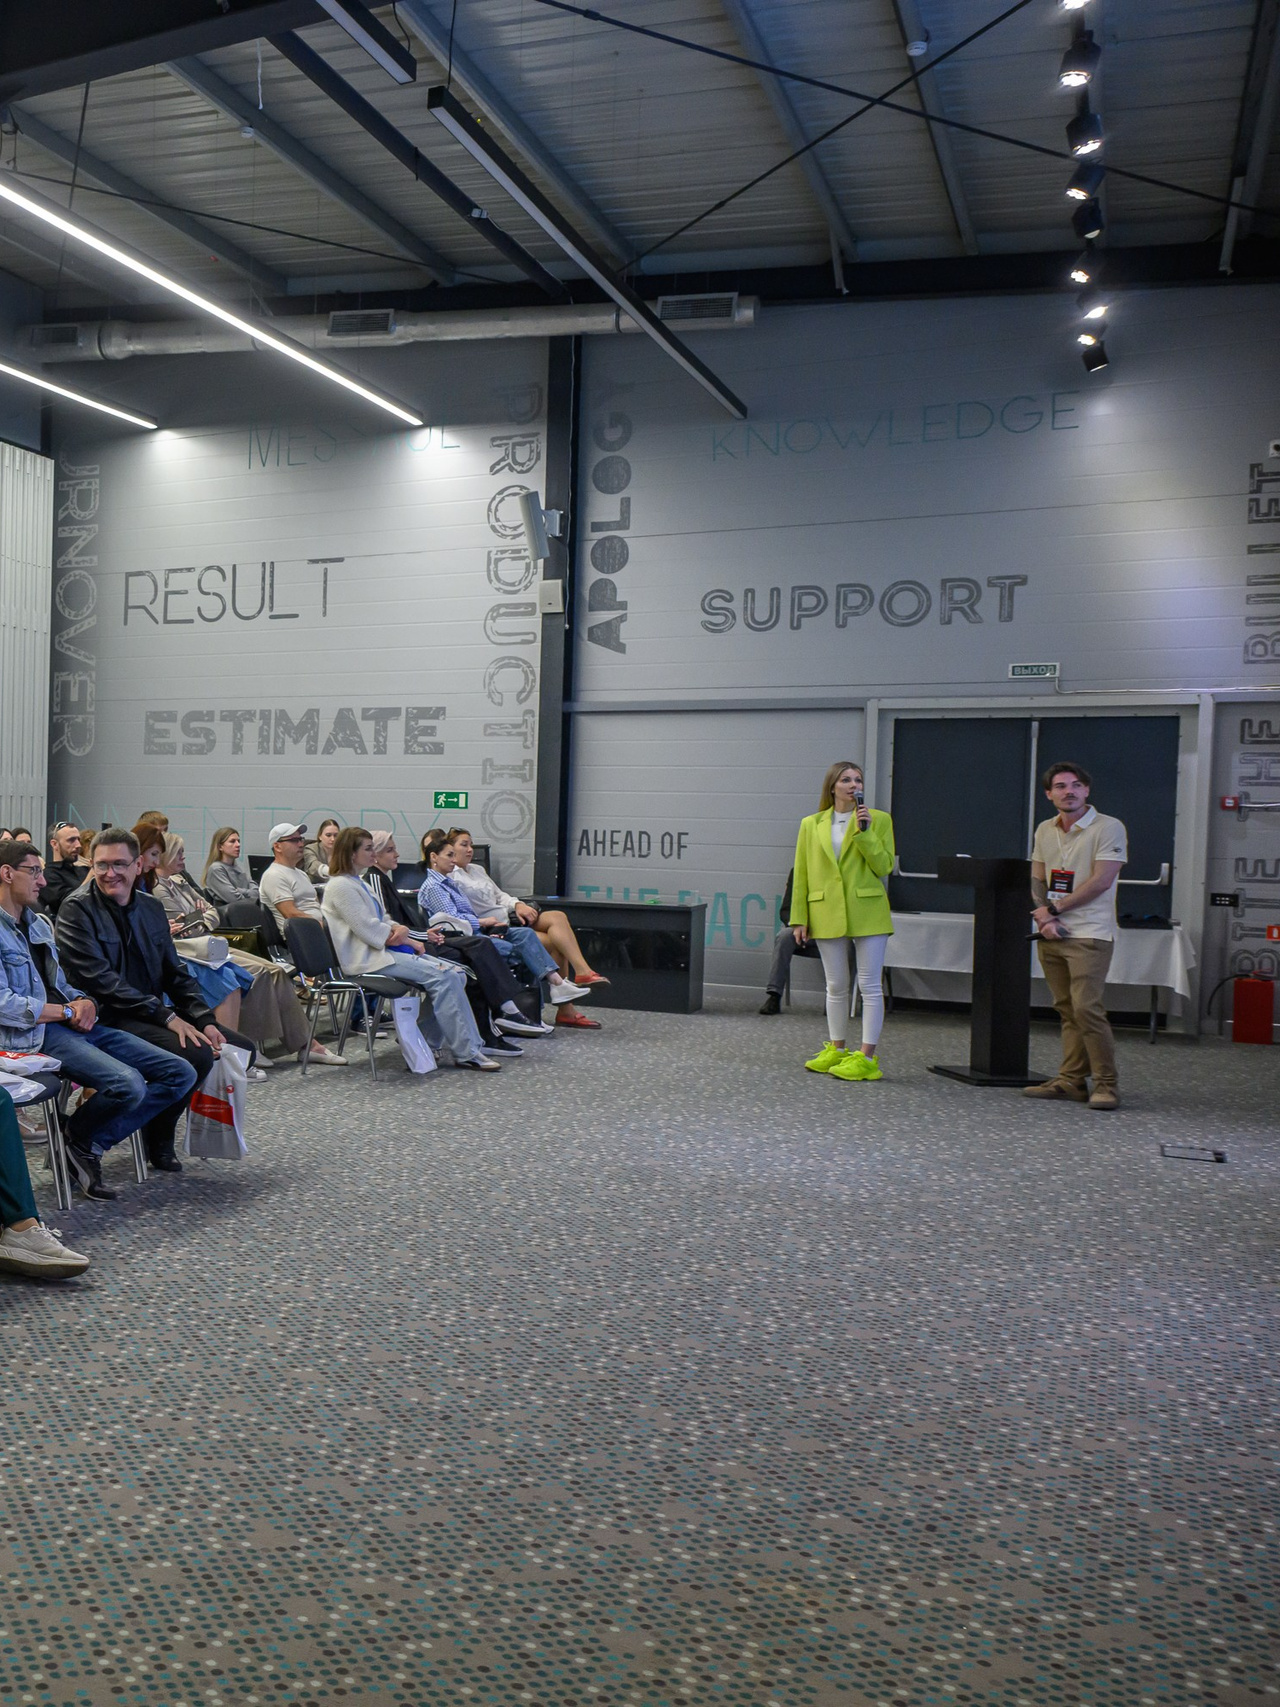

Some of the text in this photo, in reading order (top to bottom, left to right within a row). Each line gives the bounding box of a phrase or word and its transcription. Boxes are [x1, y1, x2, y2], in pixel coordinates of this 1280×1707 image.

[710, 390, 1081, 462] KNOWLEDGE
[52, 452, 100, 757] URNOVER
[123, 556, 345, 626] RESULT
[699, 574, 1028, 634] SUPPORT
[1014, 666, 1054, 675] ВЫХОД
[143, 706, 447, 756] ESTIMATE
[577, 829, 689, 860] AHEAD OF
